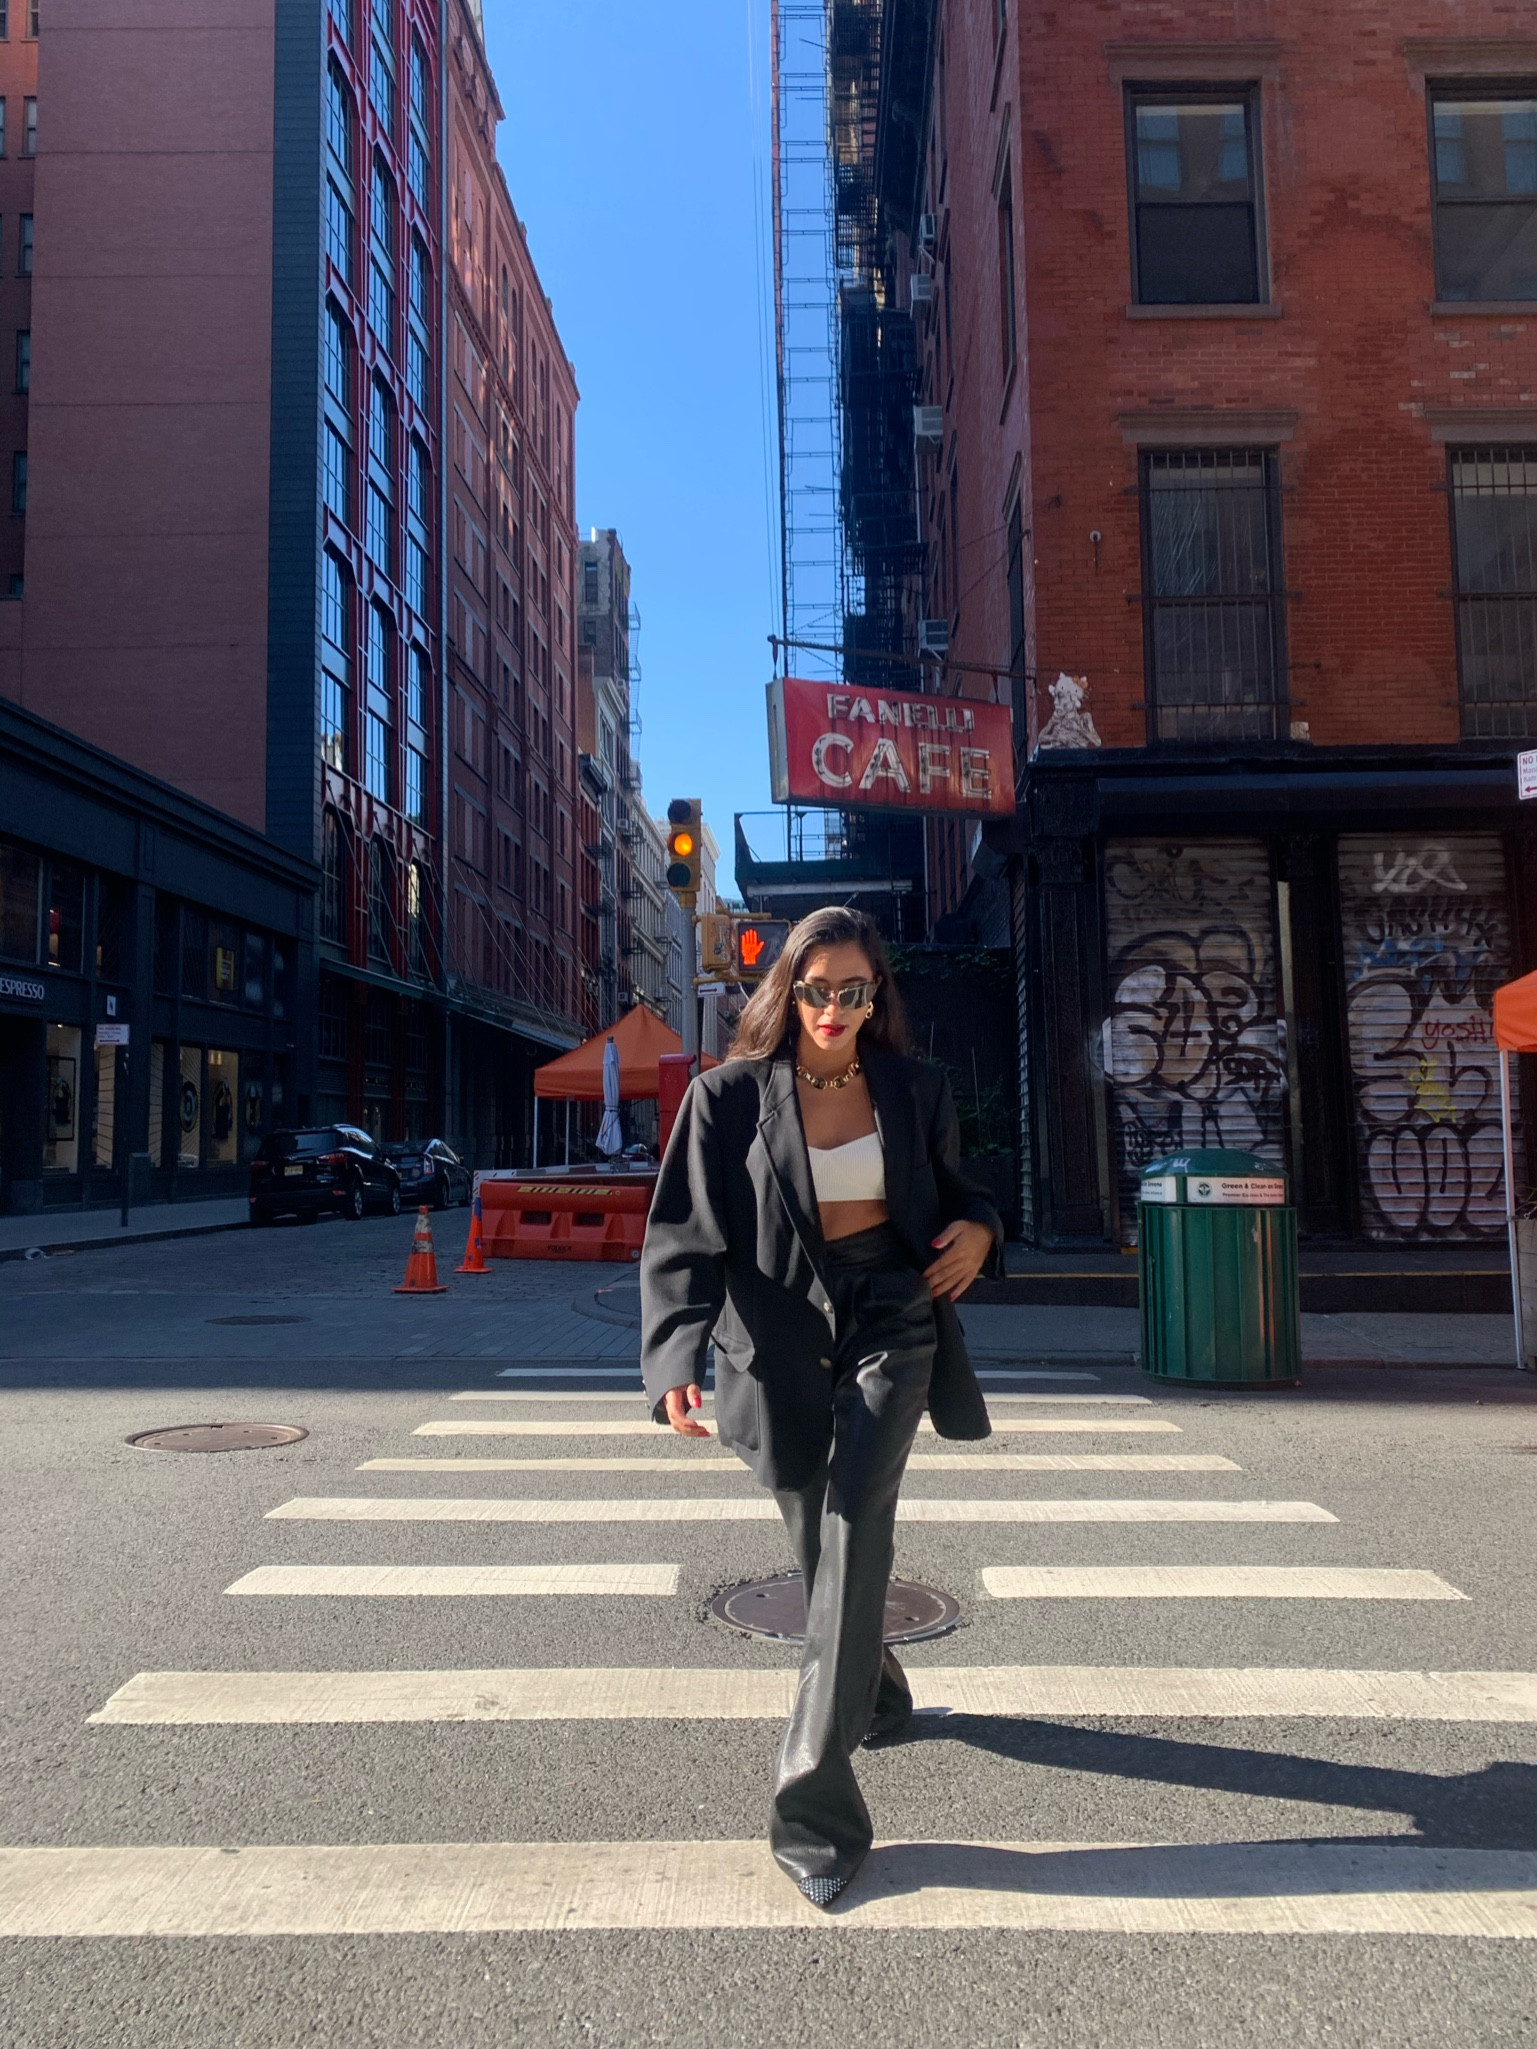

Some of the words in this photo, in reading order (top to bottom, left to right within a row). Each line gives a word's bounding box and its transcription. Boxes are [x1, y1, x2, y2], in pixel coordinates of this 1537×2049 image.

[826, 692, 976, 733] FANELLI
[811, 732, 993, 800] CAFE
[1522, 755, 1534, 766] NO
